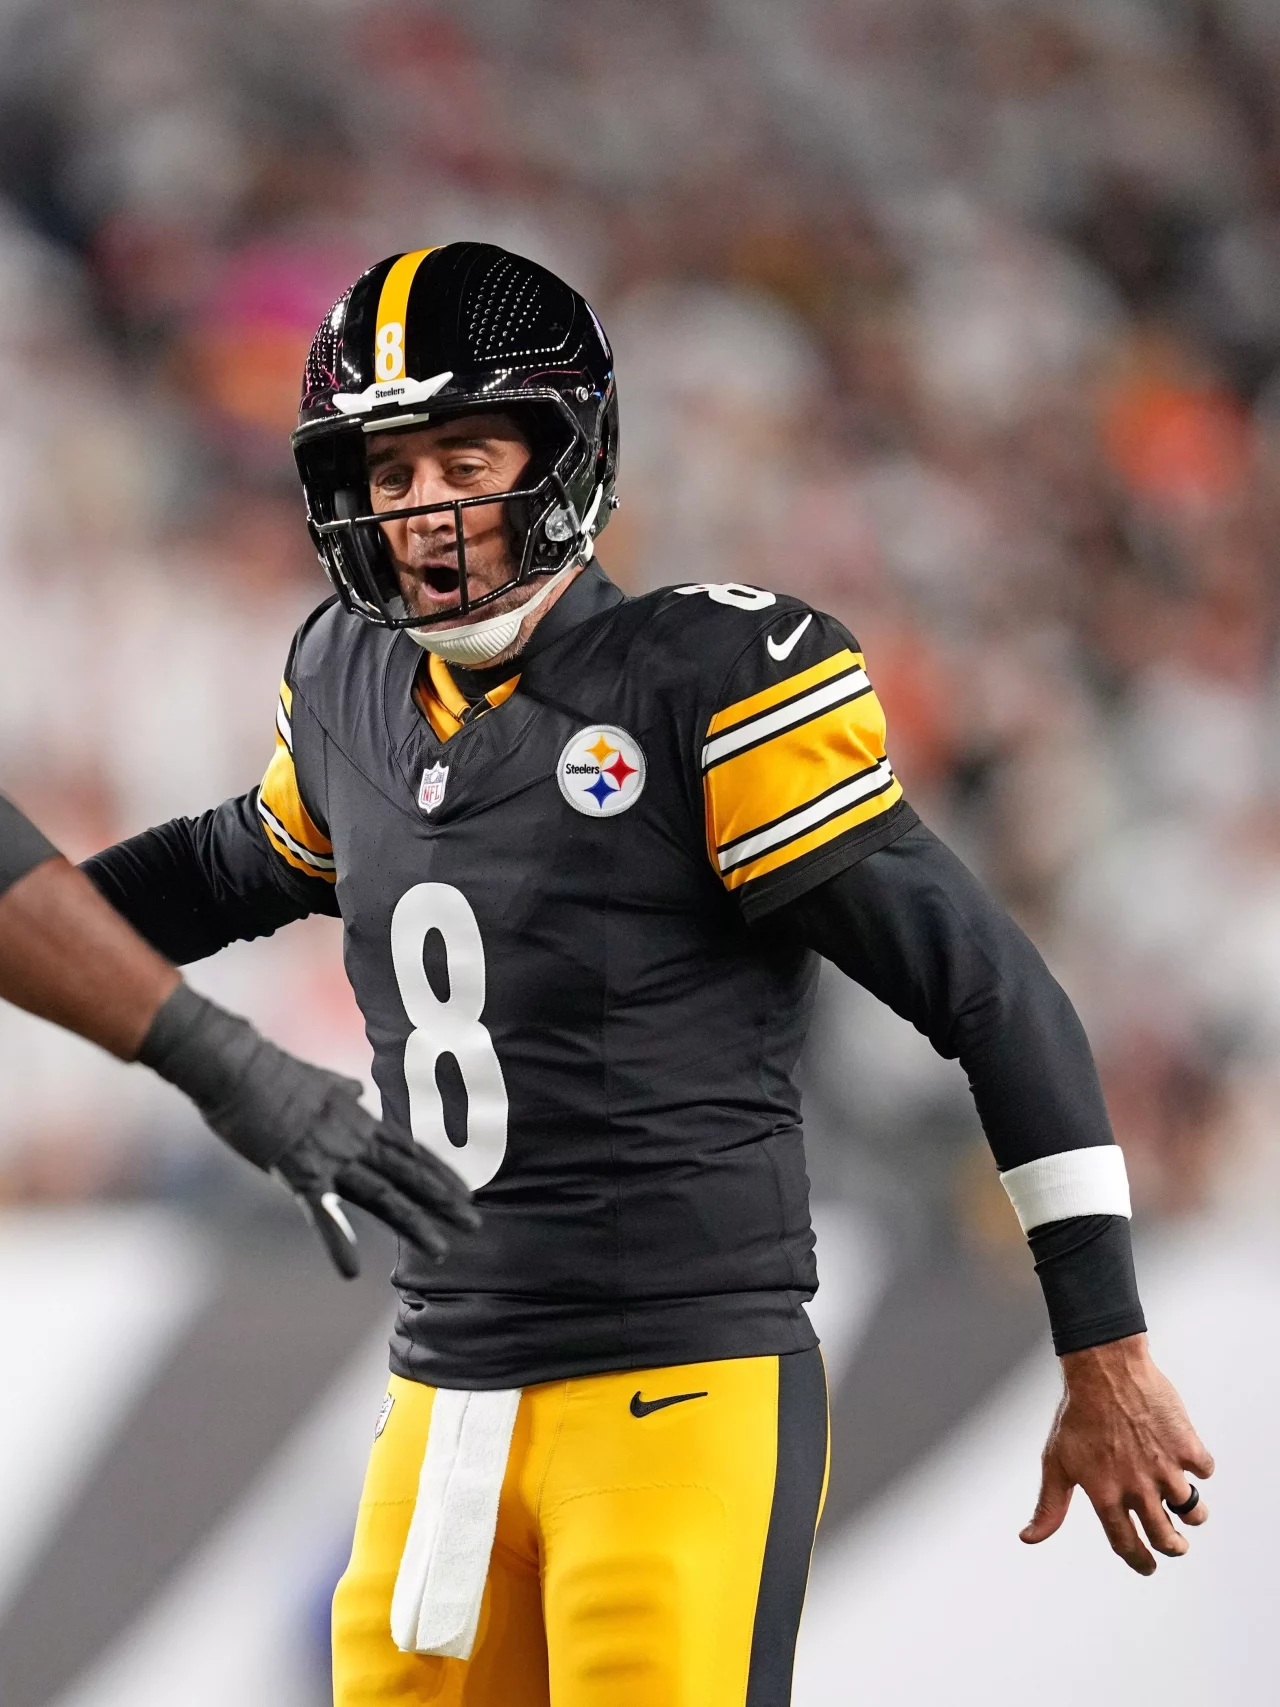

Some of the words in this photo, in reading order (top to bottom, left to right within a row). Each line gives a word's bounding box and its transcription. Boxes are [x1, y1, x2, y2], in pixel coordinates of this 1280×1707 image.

[376, 322, 403, 381] 8
[375, 387, 405, 399] Steelers
[565, 763, 600, 775] Steelers
[423, 785, 440, 803] NFL
[390, 882, 509, 1193] 8
